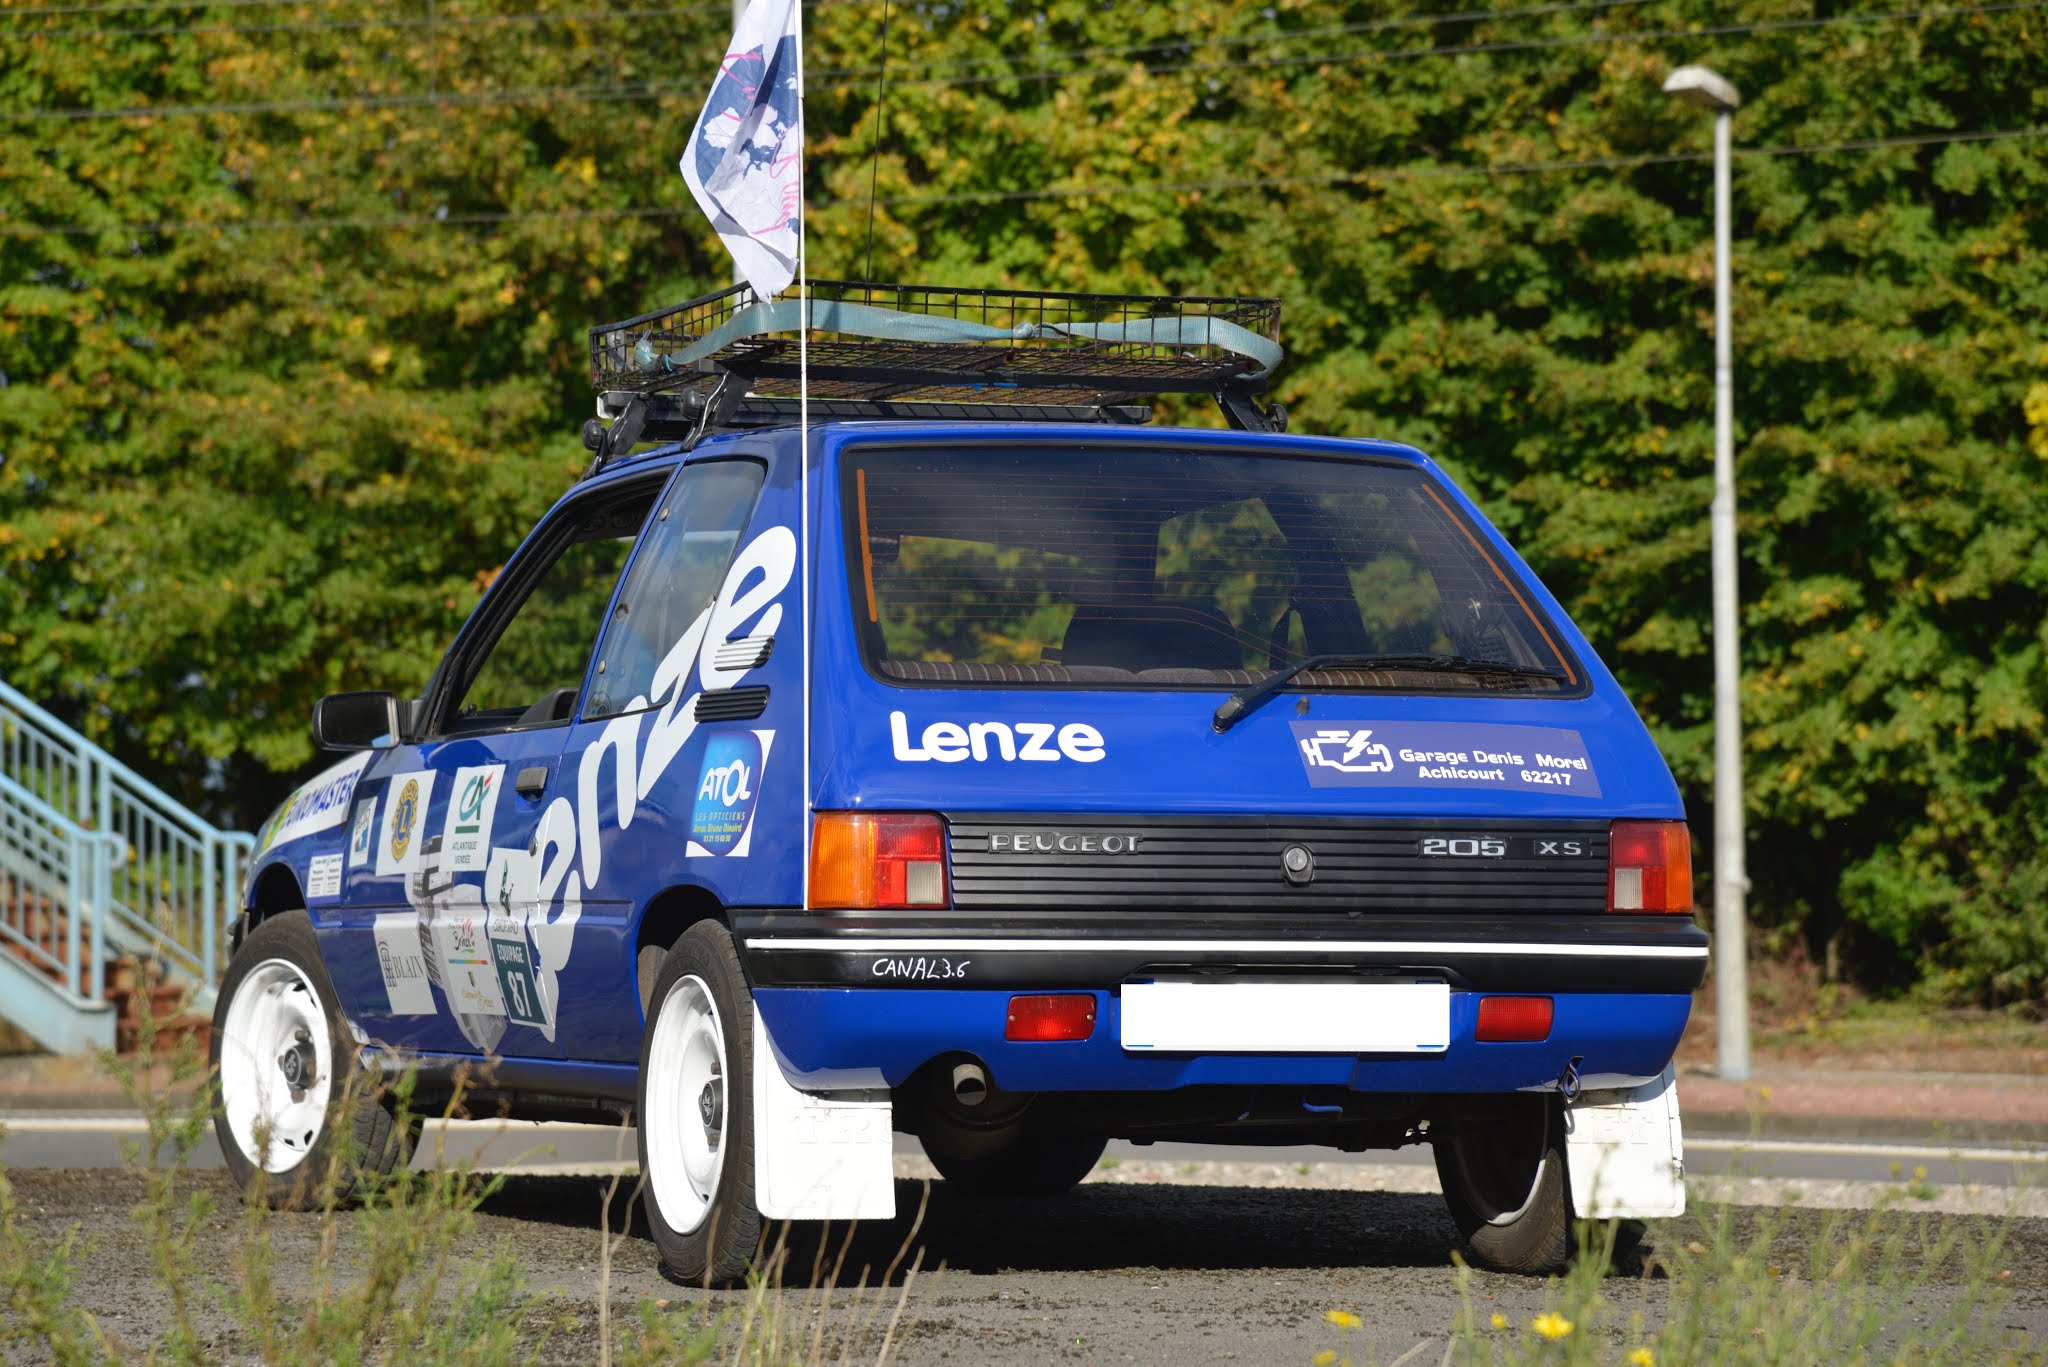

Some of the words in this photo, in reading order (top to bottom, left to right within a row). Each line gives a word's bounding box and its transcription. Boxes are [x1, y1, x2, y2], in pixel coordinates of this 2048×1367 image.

[890, 711, 1106, 763] Lenze
[1399, 748, 1469, 765] Garage
[1473, 750, 1525, 766] Denis
[1535, 753, 1589, 771] Morel
[699, 759, 752, 807] ATOL
[1418, 765, 1506, 782] Achicourt
[1520, 770, 1573, 786] 62217
[695, 812, 706, 821] LES
[708, 811, 746, 821] OPTICIENS
[452, 841, 478, 851] ATLANTIQUE
[991, 834, 1139, 852] PEUGEOT
[1423, 838, 1506, 857] 205
[1539, 840, 1583, 856] XS
[496, 943, 525, 964] EQUIPAGE
[391, 955, 425, 979] BLAIN
[507, 970, 533, 1017] 87
